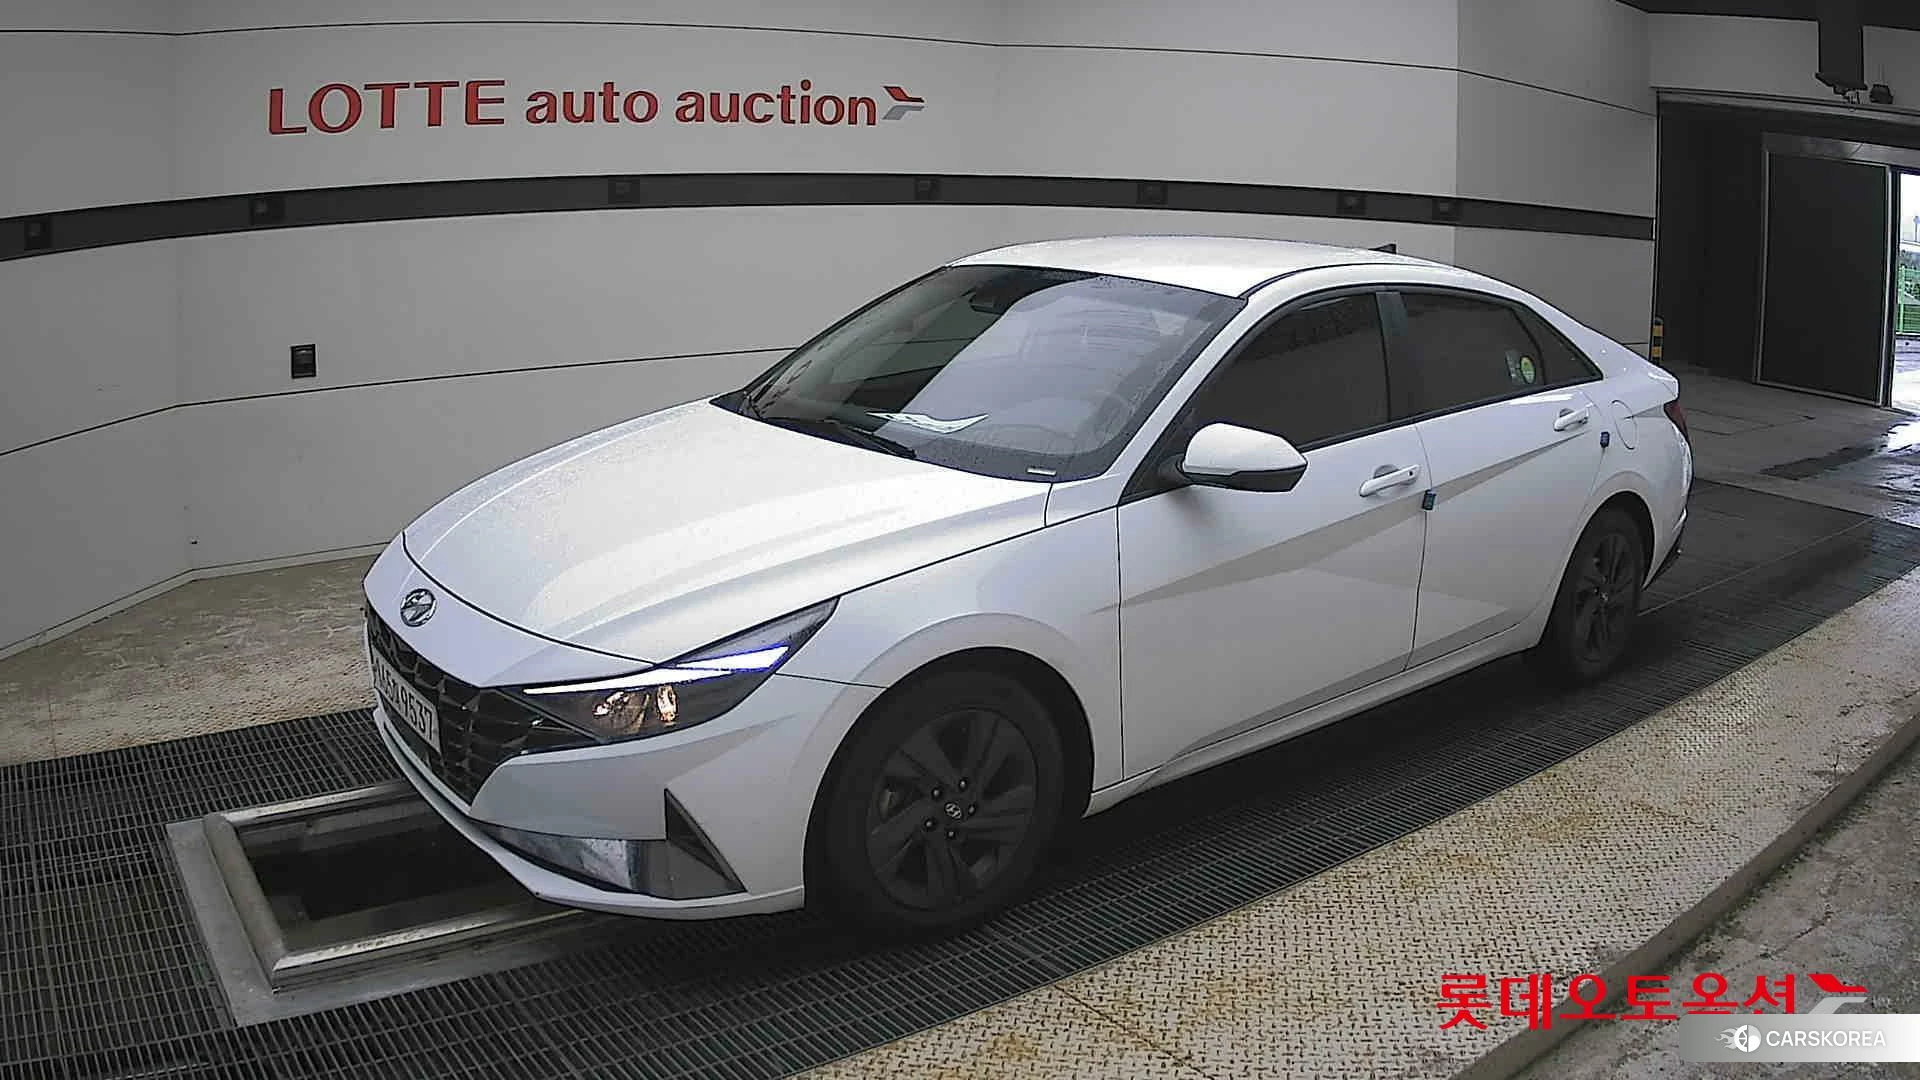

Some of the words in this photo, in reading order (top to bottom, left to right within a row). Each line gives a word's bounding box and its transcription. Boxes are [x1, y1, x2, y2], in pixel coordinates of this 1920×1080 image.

[268, 79, 506, 135] LOTTE
[525, 81, 658, 125] auto
[675, 79, 878, 127] auction
